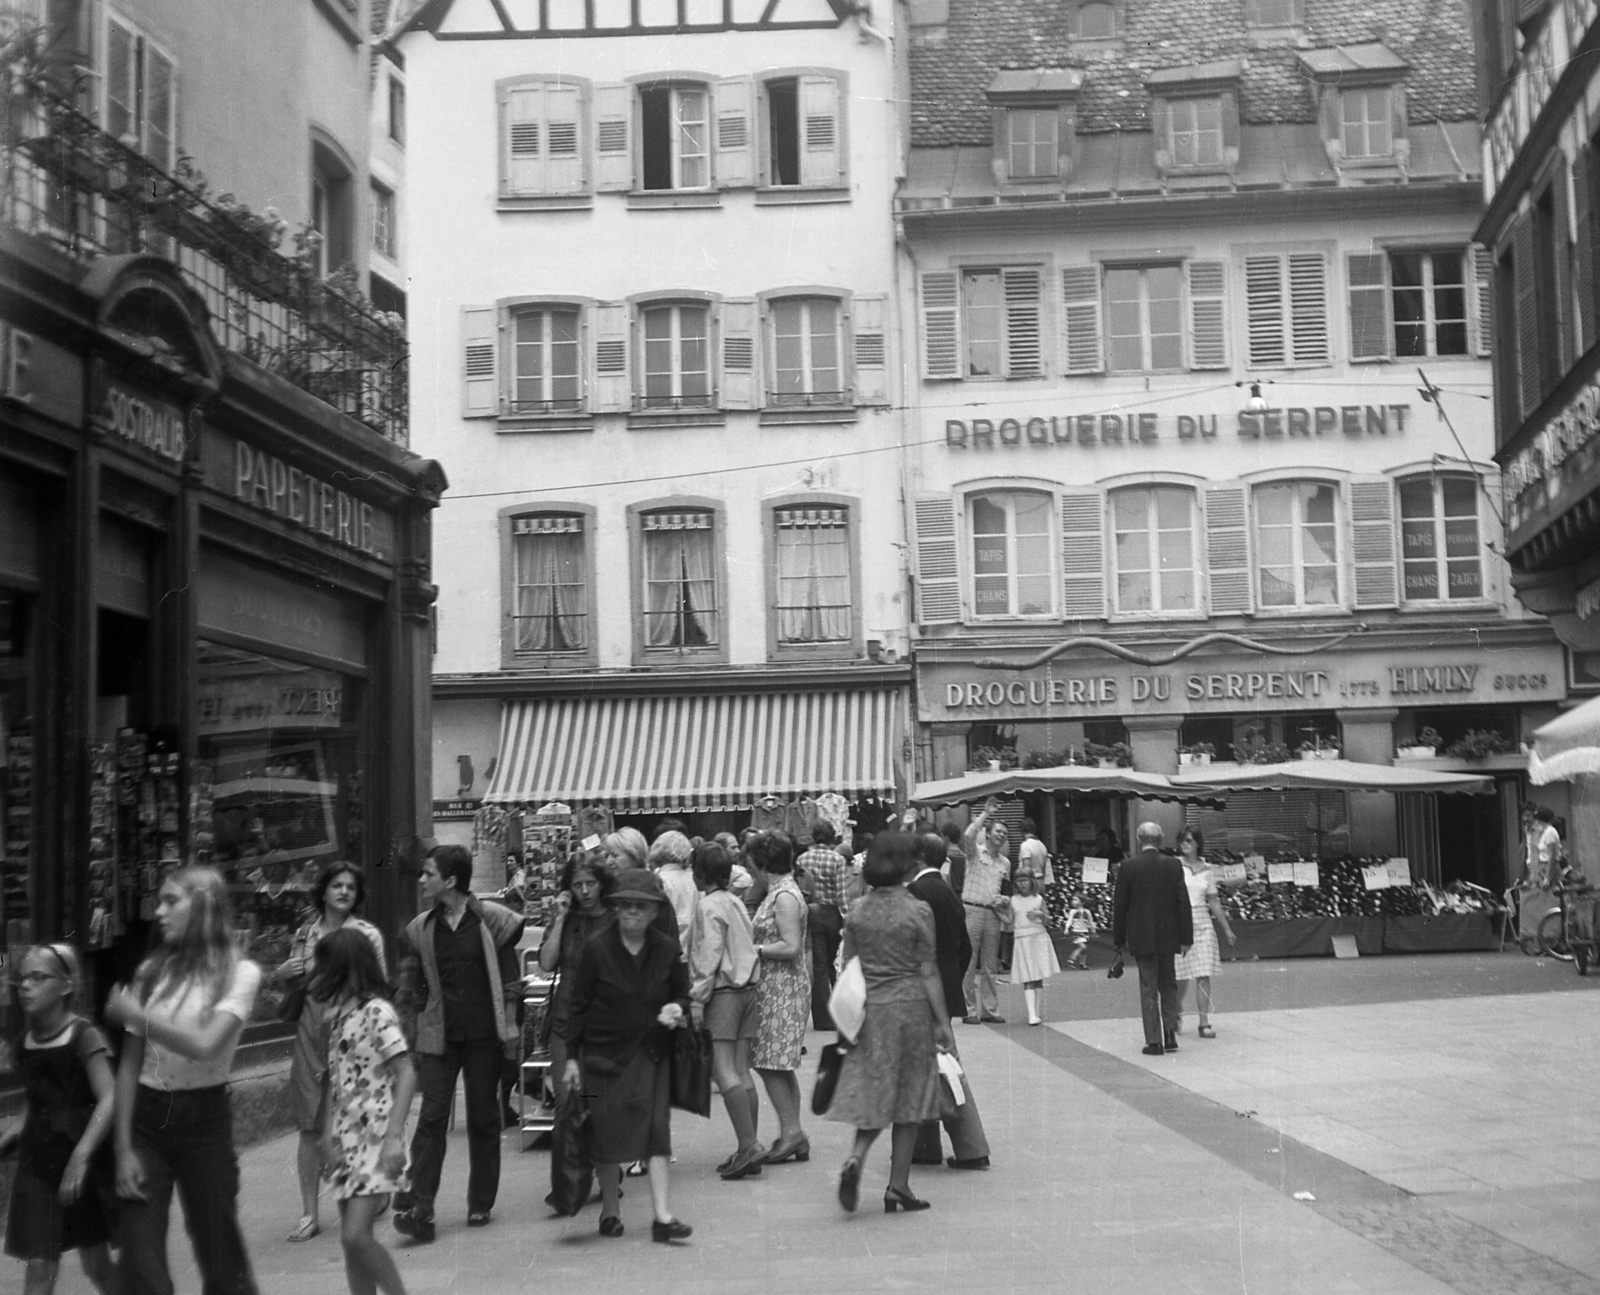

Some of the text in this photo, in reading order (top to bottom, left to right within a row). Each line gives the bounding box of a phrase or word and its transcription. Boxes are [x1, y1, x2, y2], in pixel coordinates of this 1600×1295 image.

[946, 404, 1410, 448] DROGUERIE DU SERPENT
[1406, 534, 1433, 547] TAPIS
[946, 678, 1118, 708] DROGUERIE
[1132, 675, 1171, 701] DU
[1186, 671, 1327, 700] SERPENT
[1389, 664, 1478, 694] HIMLY
